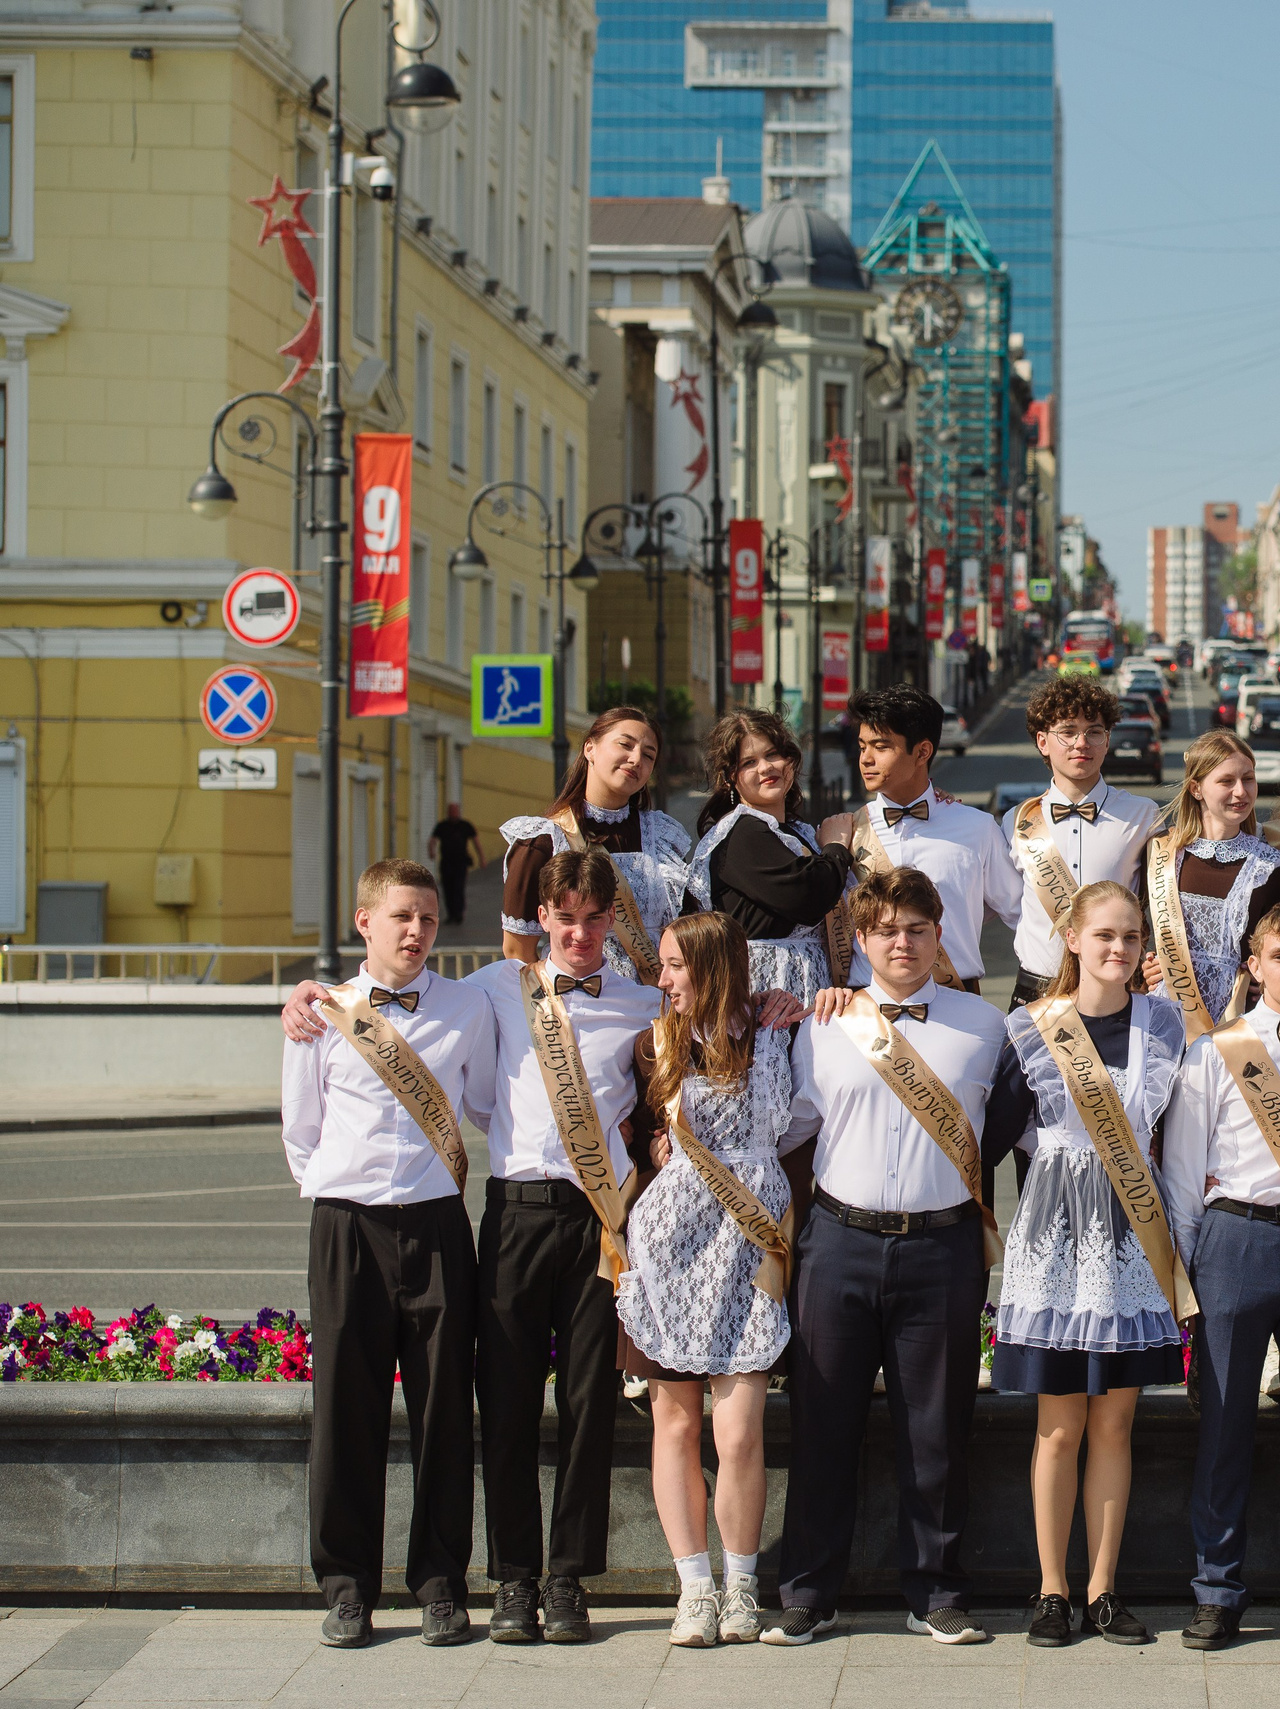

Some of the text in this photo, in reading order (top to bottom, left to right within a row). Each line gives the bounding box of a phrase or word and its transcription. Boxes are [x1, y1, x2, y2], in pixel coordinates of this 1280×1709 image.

[363, 485, 400, 553] 9
[362, 555, 400, 574] МАЯ
[735, 548, 758, 588] 9
[1052, 856, 1072, 886] Смирнов
[832, 907, 849, 970] скница
[1152, 851, 1202, 1012] Выпускница 2025
[376, 1041, 453, 1150] Выпускник
[414, 1061, 436, 1092] Чумак
[541, 1012, 612, 1192] Выпускник 2025
[567, 1042, 594, 1122] Семёнов Артур
[928, 1074, 957, 1112] Вазеров
[892, 1058, 970, 1164] Выпускник
[1070, 1056, 1160, 1223] Выпускница 2025
[1102, 1081, 1135, 1154] Брагина Екатерина
[681, 1135, 741, 1191] Горбунова Дарья
[736, 1205, 787, 1246] 2025
